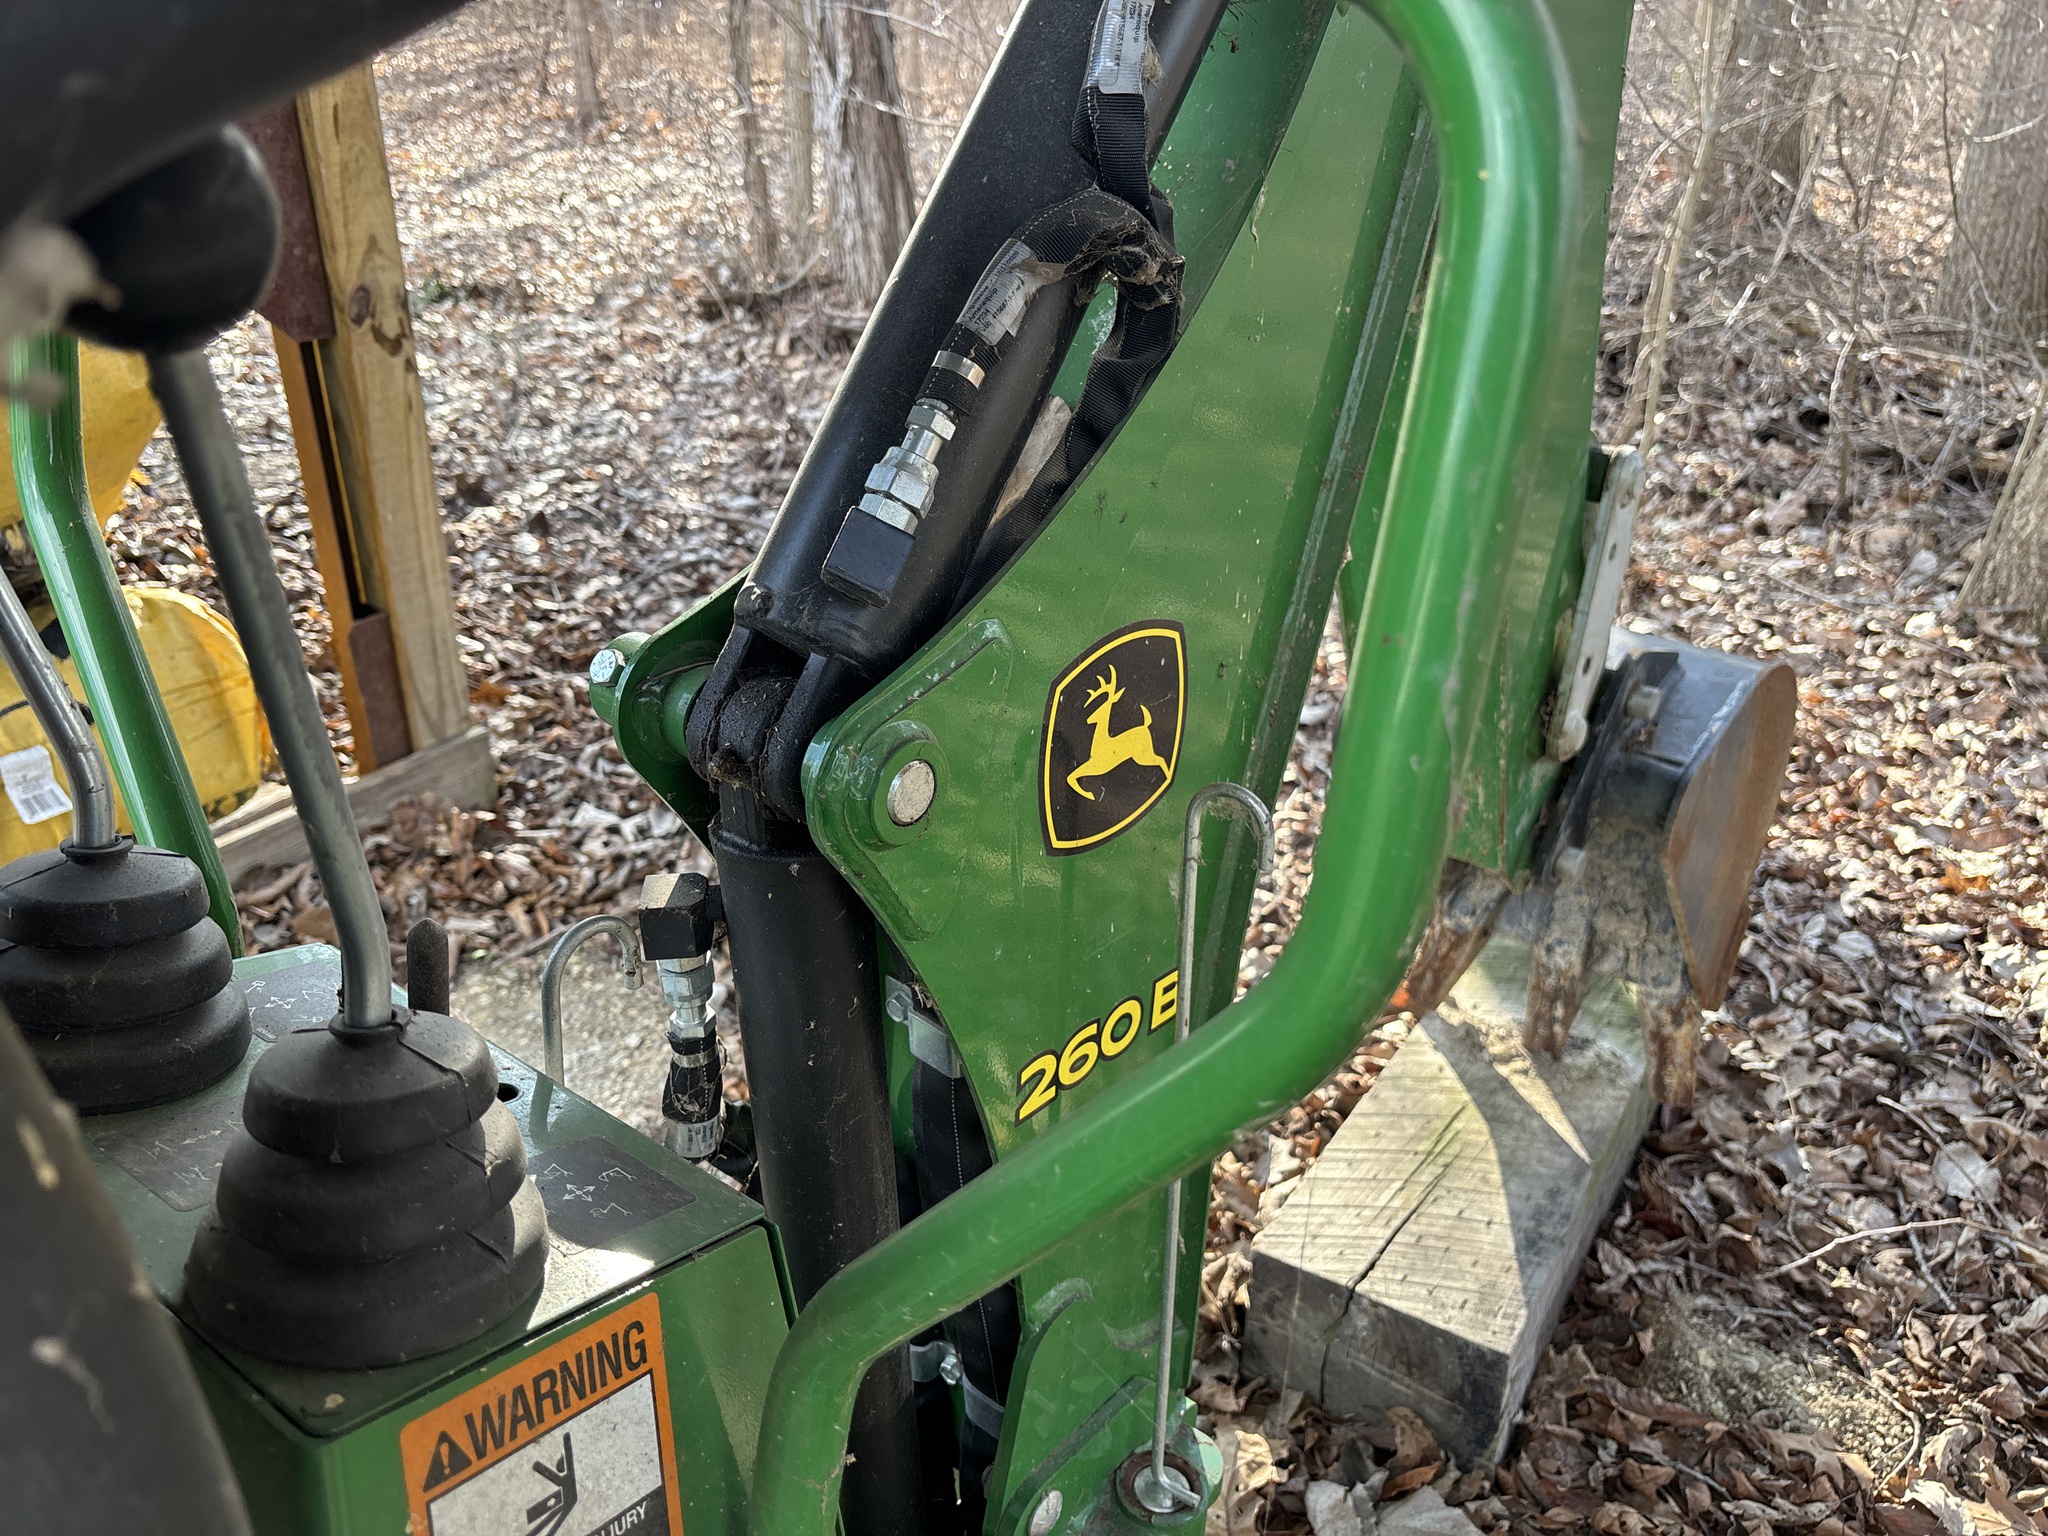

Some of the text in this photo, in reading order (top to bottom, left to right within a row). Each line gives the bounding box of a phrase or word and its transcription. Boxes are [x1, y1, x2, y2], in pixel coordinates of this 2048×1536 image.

[968, 287, 998, 323] Amerequip
[1016, 996, 1143, 1126] 260
[464, 1320, 648, 1461] WARNING
